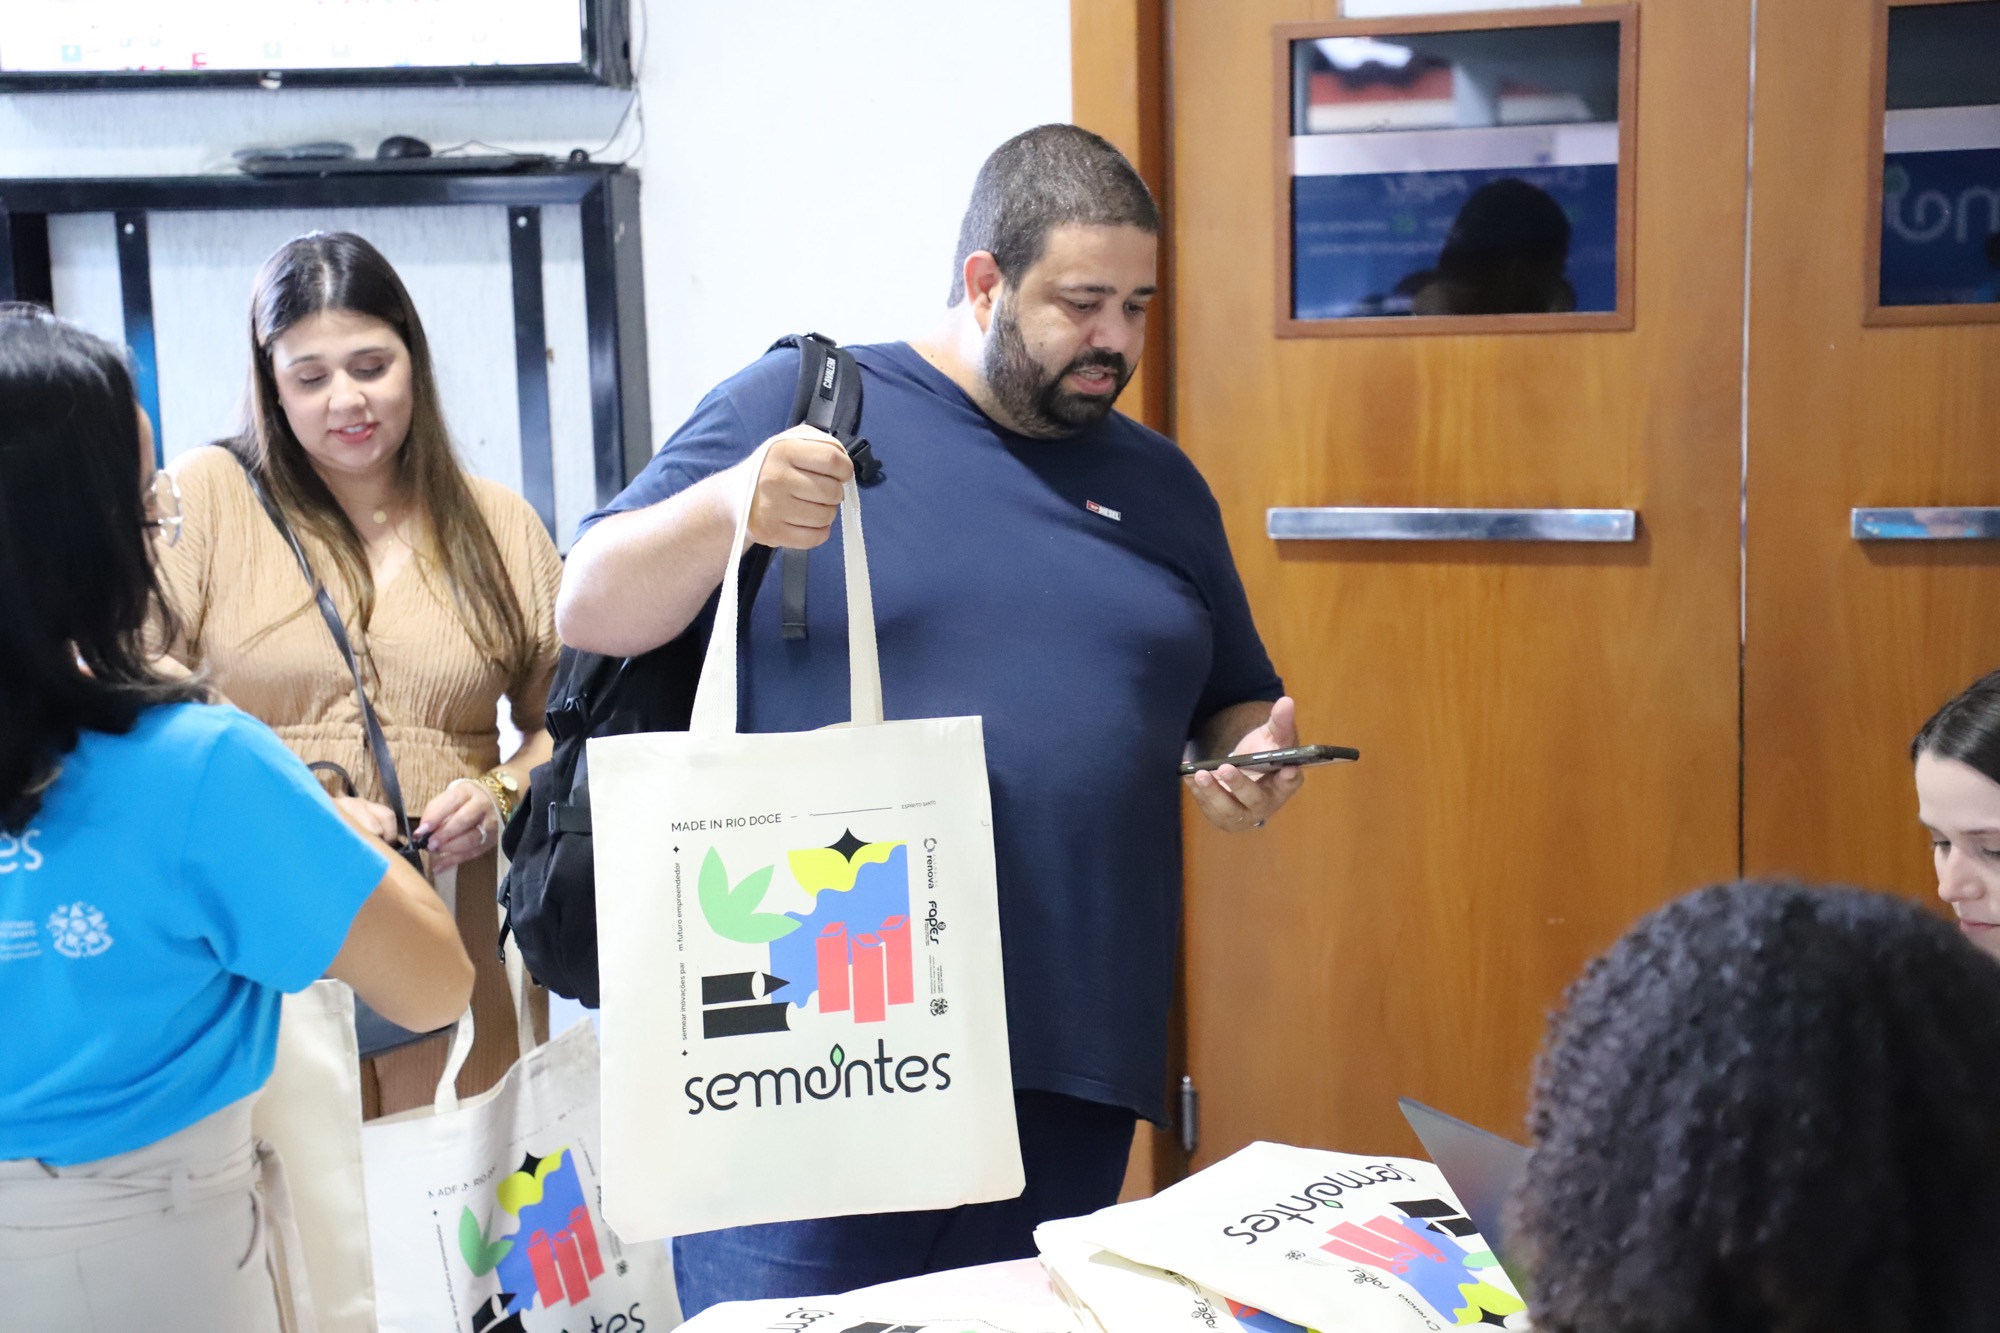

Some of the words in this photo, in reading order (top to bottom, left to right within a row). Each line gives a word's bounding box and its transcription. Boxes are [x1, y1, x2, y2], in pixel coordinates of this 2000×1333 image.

[671, 820, 706, 832] MADE
[710, 819, 723, 829] IN
[726, 817, 746, 828] RIO
[749, 813, 782, 826] DOCE
[926, 855, 935, 889] renova
[673, 862, 684, 918] empreendedor
